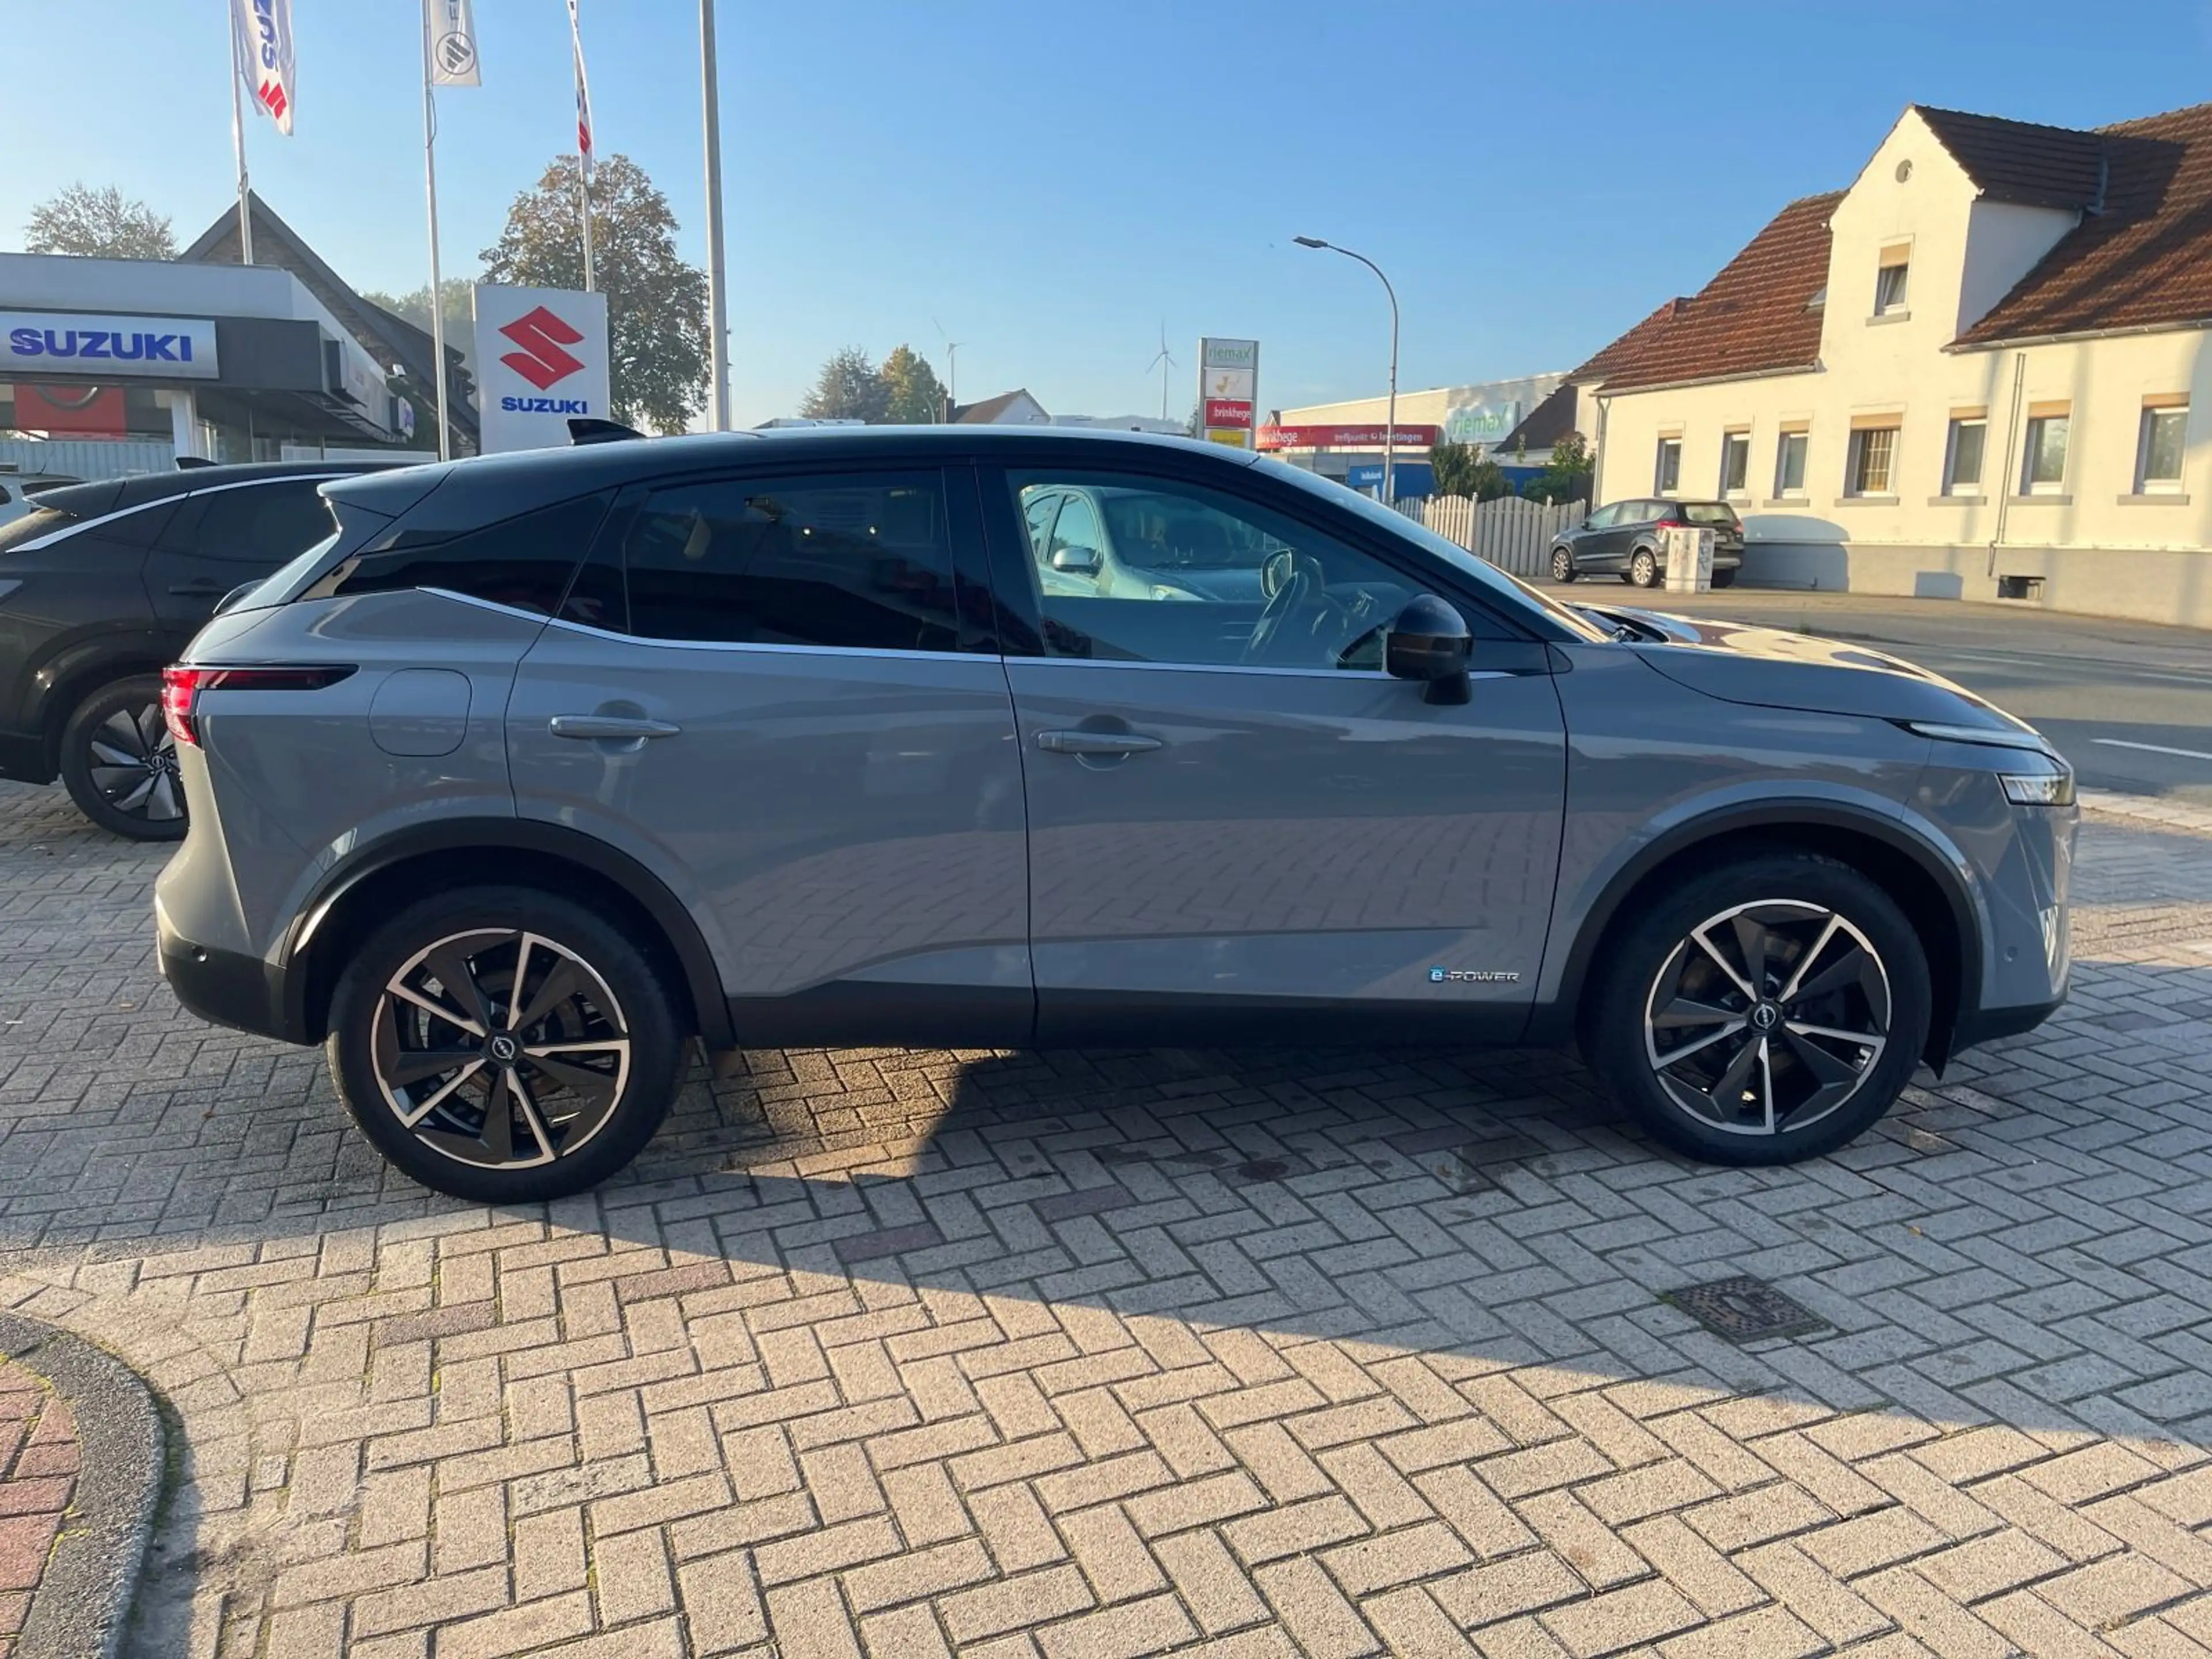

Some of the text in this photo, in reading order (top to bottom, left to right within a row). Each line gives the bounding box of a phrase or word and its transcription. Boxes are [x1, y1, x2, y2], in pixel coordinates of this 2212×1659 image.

[10, 328, 192, 362] SUZUKI
[501, 396, 588, 414] SUZUKI
[1453, 403, 1509, 435] riemax
